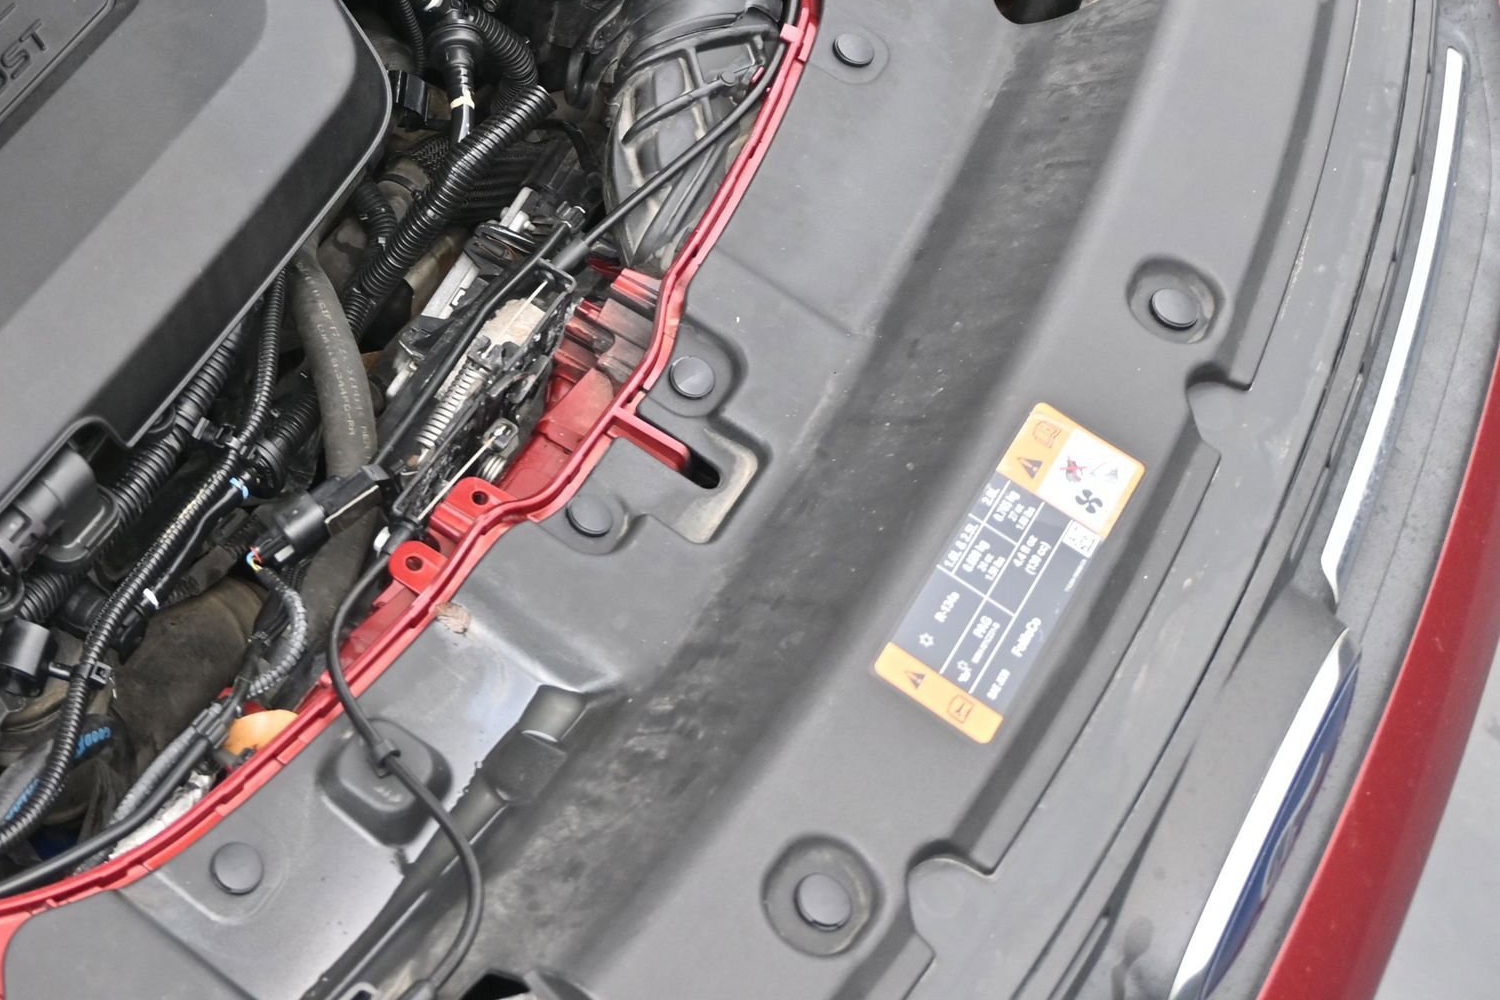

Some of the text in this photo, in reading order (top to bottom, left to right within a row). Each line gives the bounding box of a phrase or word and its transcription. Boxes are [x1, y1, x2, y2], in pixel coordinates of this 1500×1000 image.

[1004, 490, 1020, 502] kg
[1014, 503, 1024, 513] oz
[974, 539, 990, 552] kg
[1013, 551, 1026, 566] 4.4
[1026, 535, 1037, 547] oz
[984, 553, 993, 563] oz
[1024, 541, 1051, 575] (130 cc)
[934, 591, 959, 622] R-134a
[973, 615, 992, 637] PAG
[1011, 617, 1040, 656] FoMoCo
